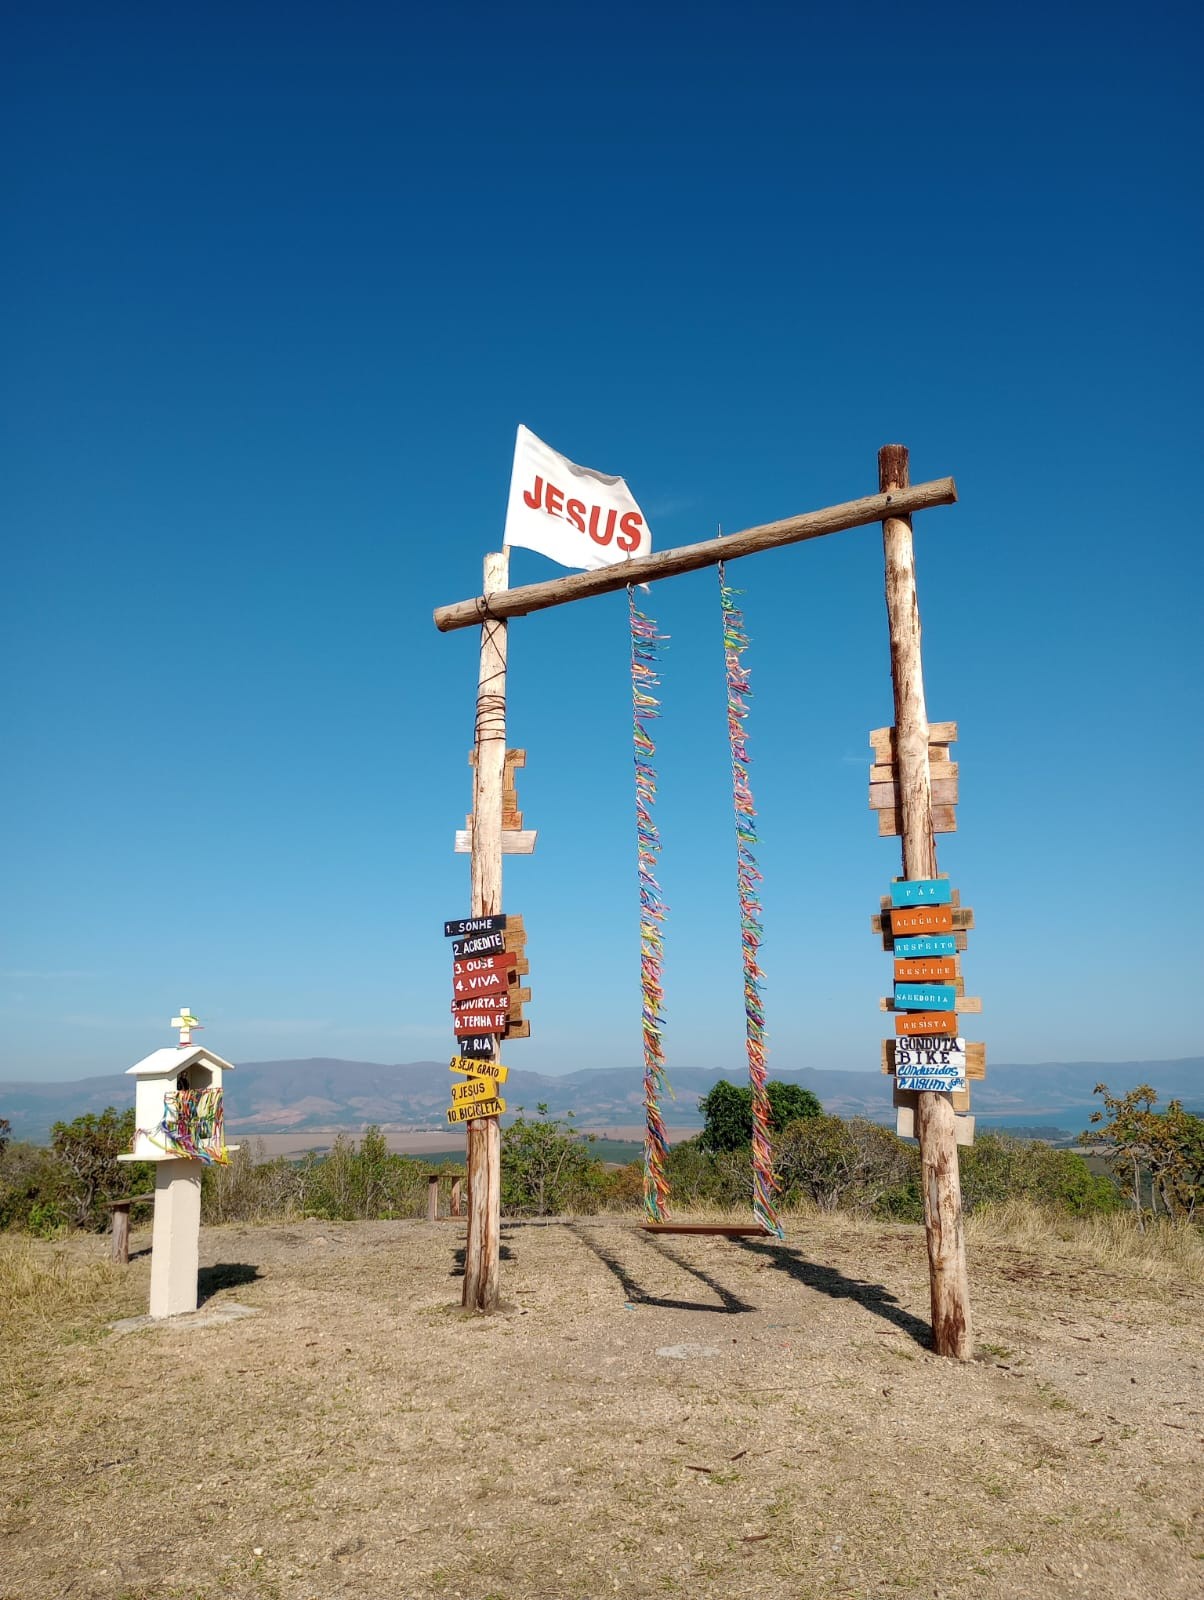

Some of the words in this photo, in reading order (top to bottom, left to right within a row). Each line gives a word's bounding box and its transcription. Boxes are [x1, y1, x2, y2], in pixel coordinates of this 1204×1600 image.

[523, 475, 643, 553] JESUS
[458, 919, 492, 932] SONHE
[896, 916, 947, 927] ALEGRIA
[463, 933, 502, 954] ACREDITE
[895, 942, 953, 951] RESPEITO
[466, 958, 495, 972] OUSE
[899, 966, 950, 975] RESPIRE
[469, 973, 500, 989] VIVA
[896, 993, 948, 1003] SABEDORIA
[463, 1014, 493, 1028] TENHA
[903, 1020, 947, 1030] RESISTA
[473, 1038, 492, 1051] RIA
[897, 1051, 950, 1065] BIKE
[457, 1058, 475, 1073] SEJA
[477, 1063, 500, 1078] GRATO
[459, 1082, 486, 1099] JESUS
[459, 1099, 503, 1119] BICICLETA
